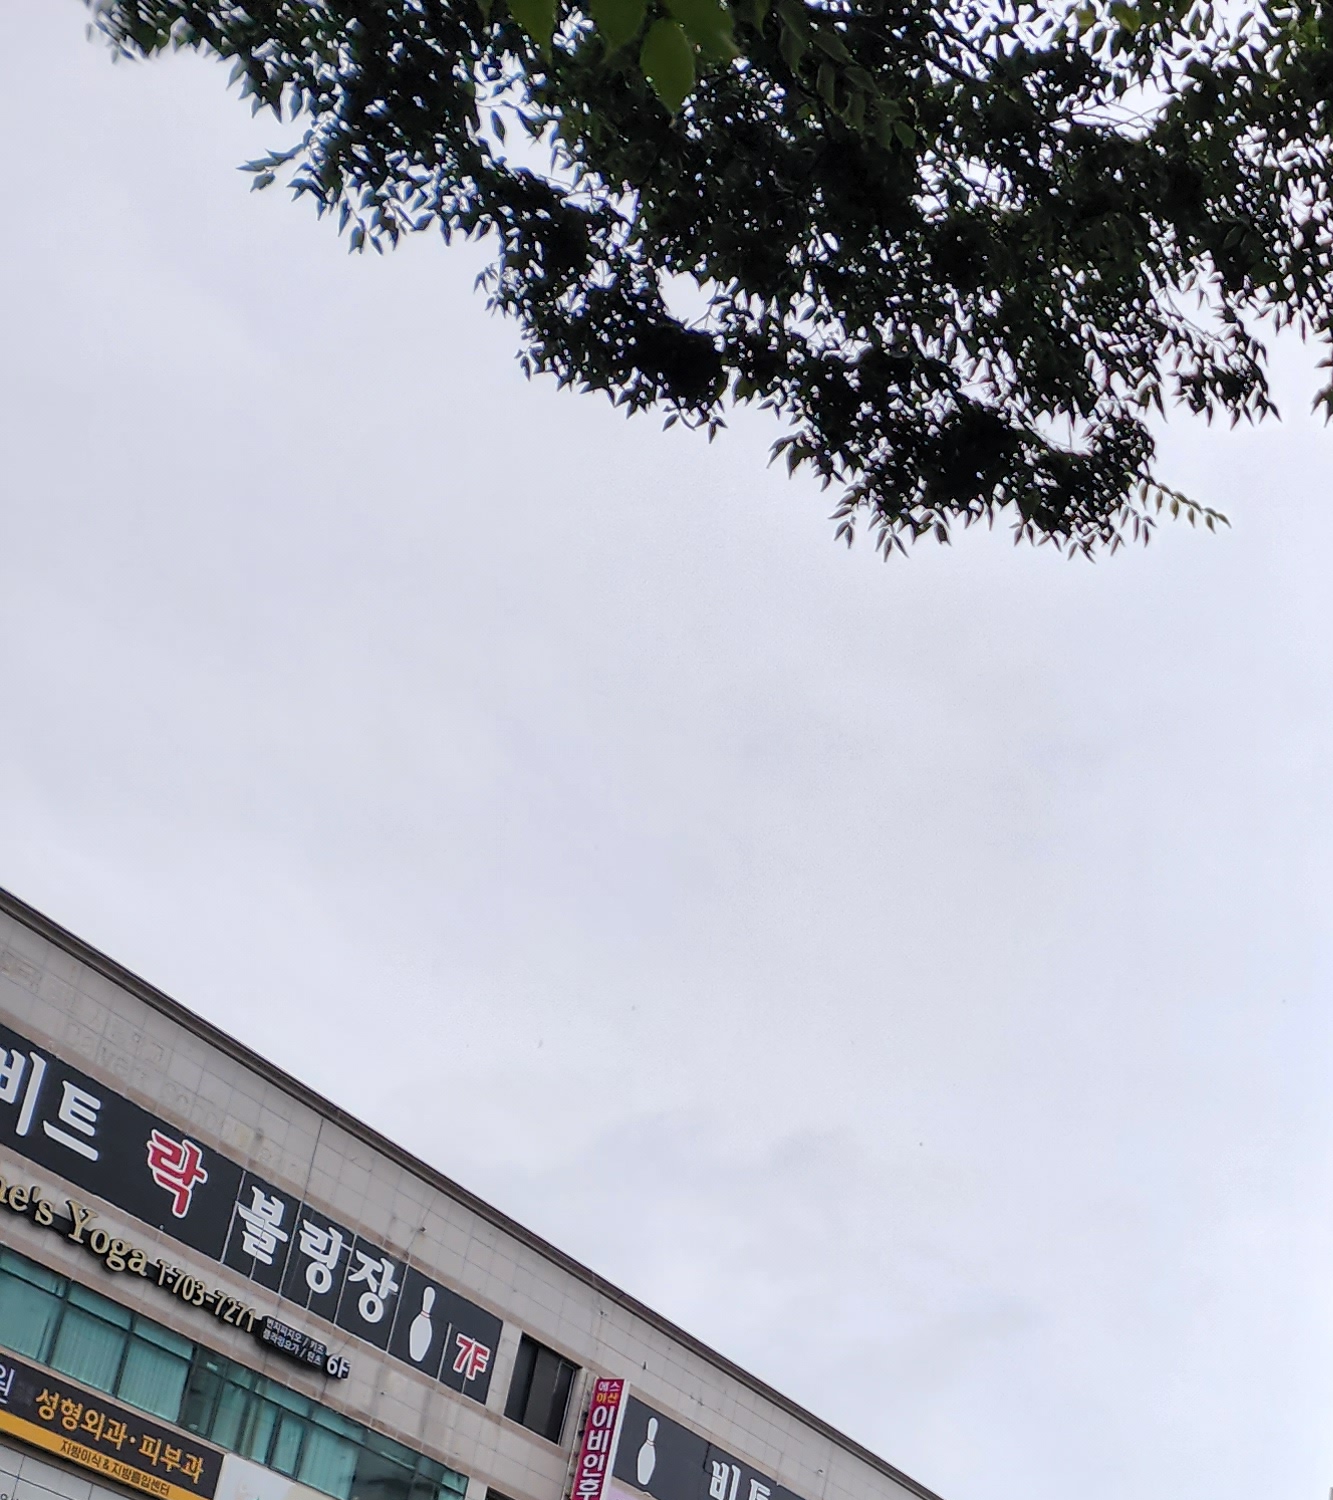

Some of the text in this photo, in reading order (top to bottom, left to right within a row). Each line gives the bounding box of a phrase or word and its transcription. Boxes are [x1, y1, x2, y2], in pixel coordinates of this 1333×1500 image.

[66, 1200, 154, 1276] Yoga
[147, 1128, 208, 1219] 락
[238, 1186, 398, 1323] 볼링장
[452, 1332, 490, 1381] 7F
[326, 1354, 351, 1379] 6F
[60, 1439, 102, 1468] 지방이식
